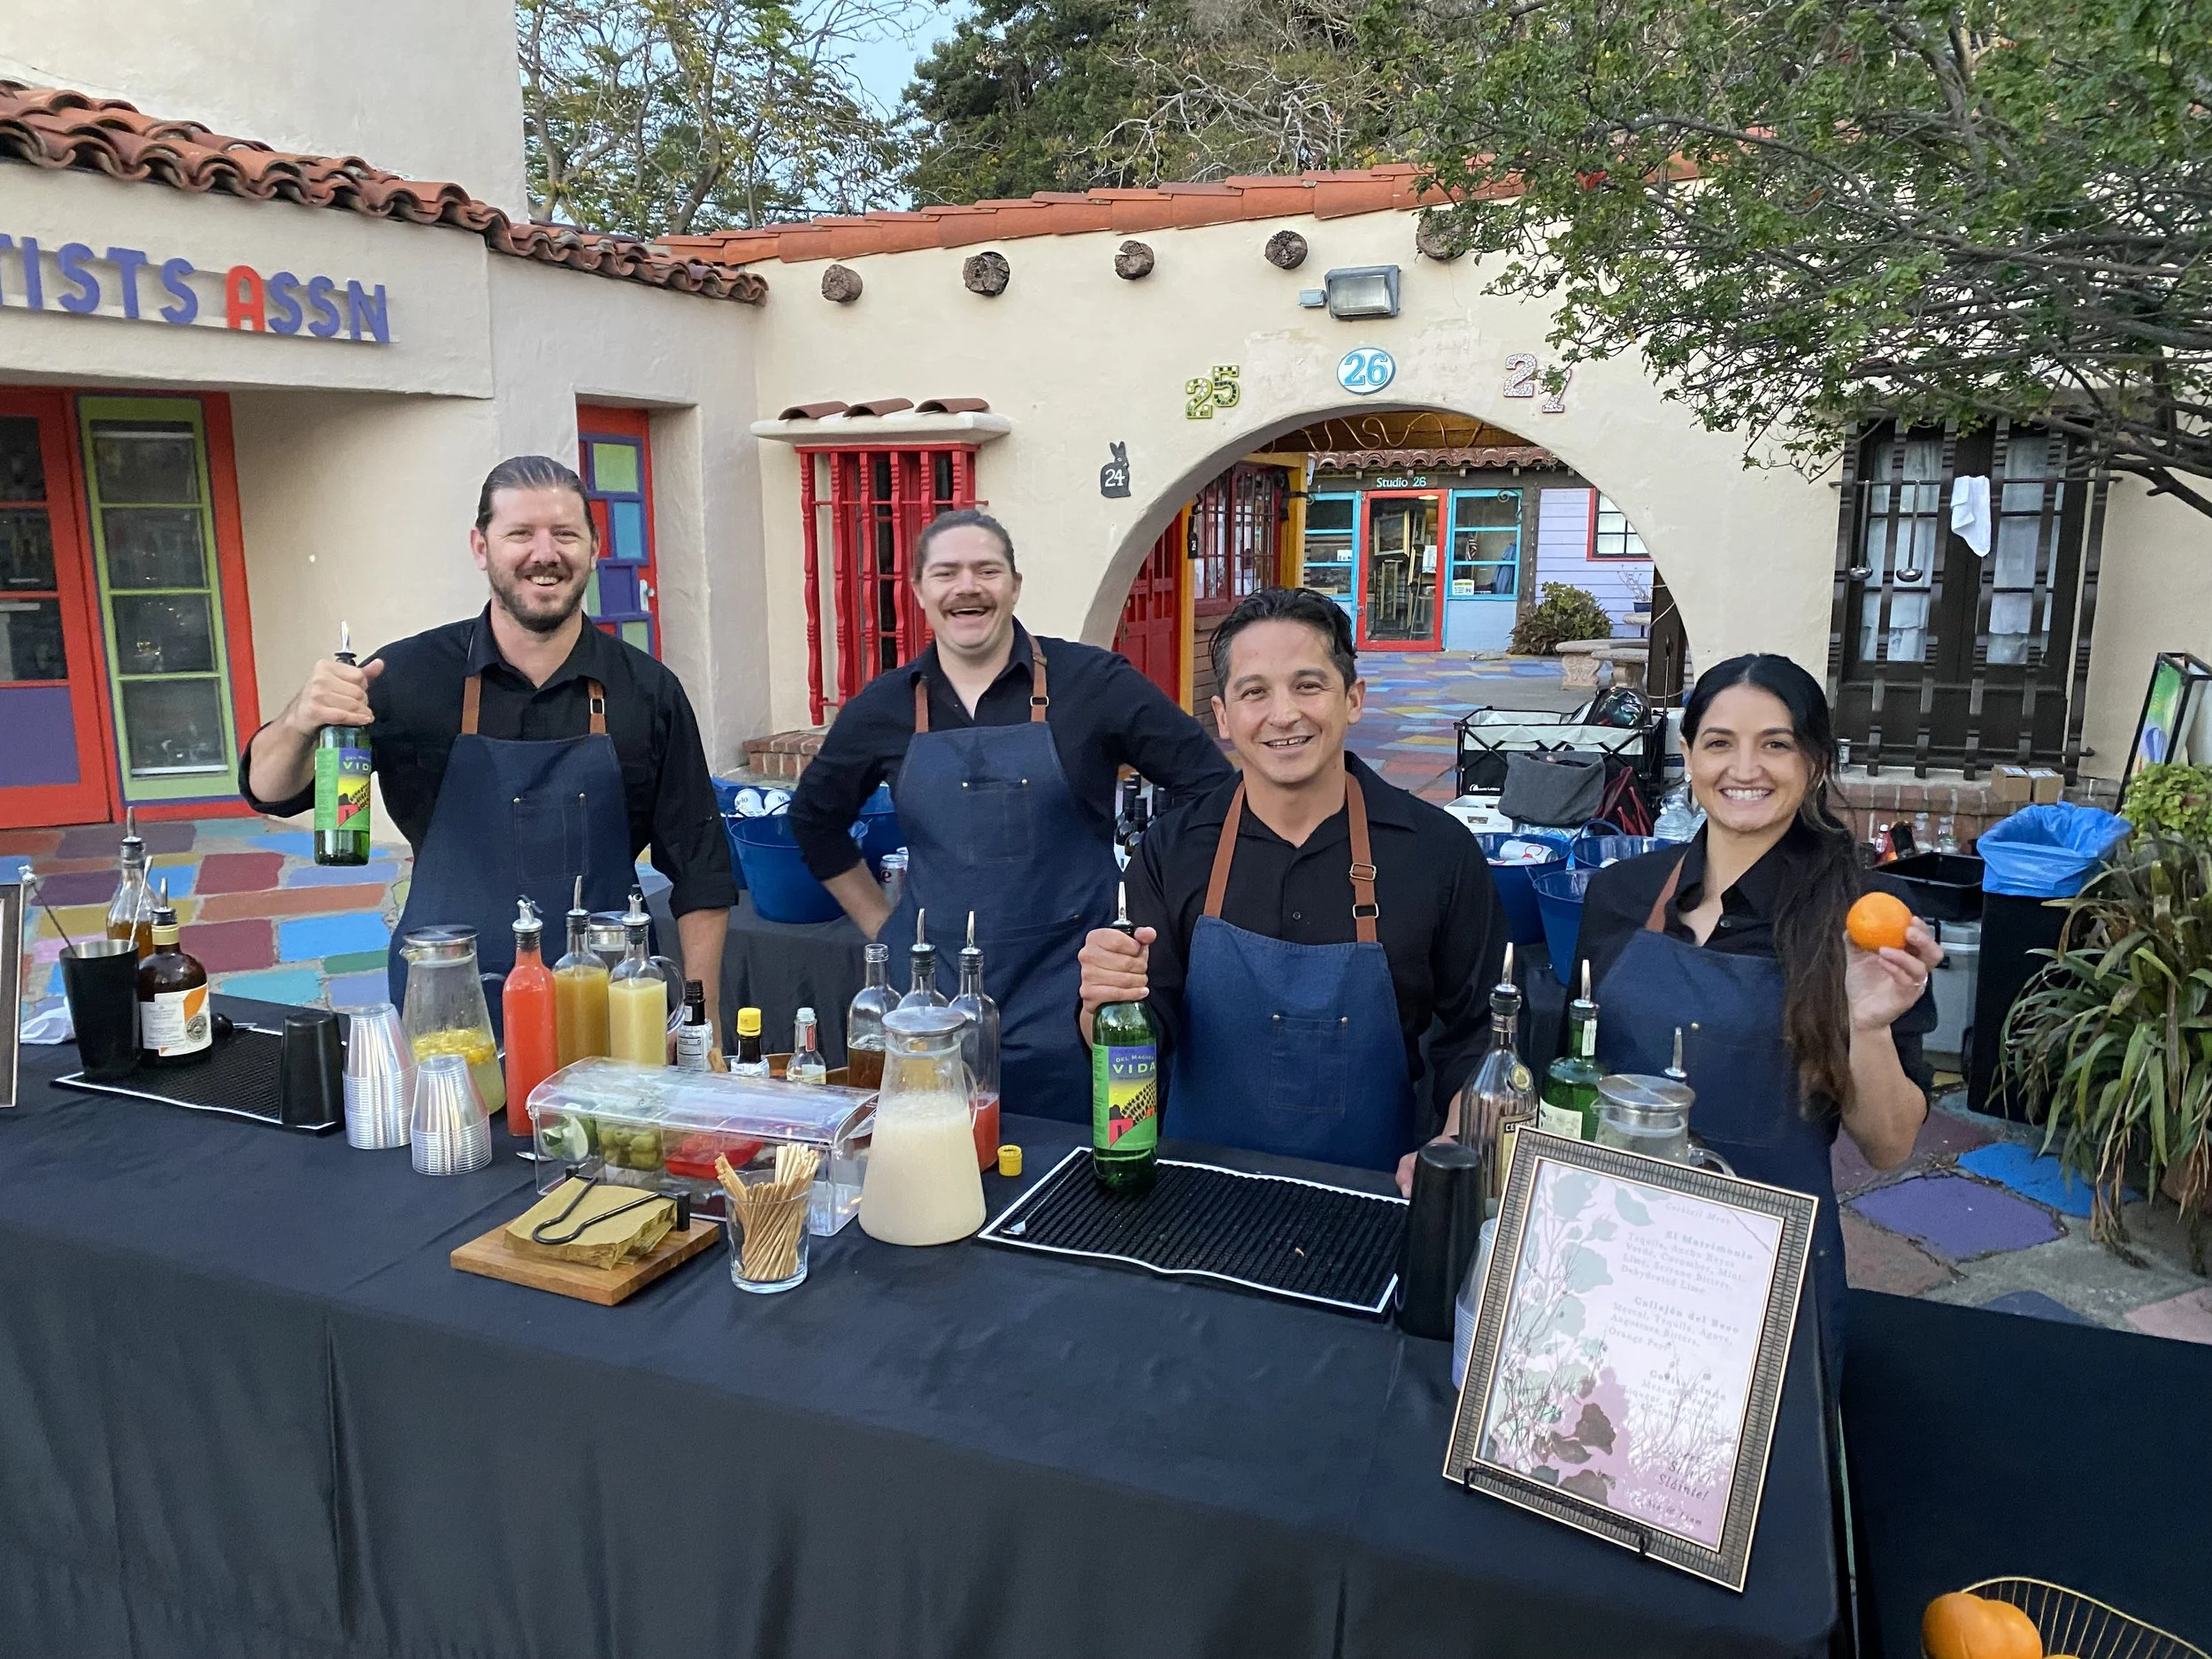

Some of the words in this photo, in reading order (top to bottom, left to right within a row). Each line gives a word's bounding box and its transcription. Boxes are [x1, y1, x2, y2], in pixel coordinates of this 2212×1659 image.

[226, 265, 390, 344] ASSN
[1345, 348, 1388, 387] 26
[1185, 365, 1240, 419] 25
[1105, 468, 1125, 488] 24
[1376, 477, 1409, 487] Studio
[1413, 476, 1426, 487] 26
[1112, 1062, 1156, 1074] VIDA
[1666, 1230, 1677, 1240] El
[1688, 1312, 1705, 1322] del
